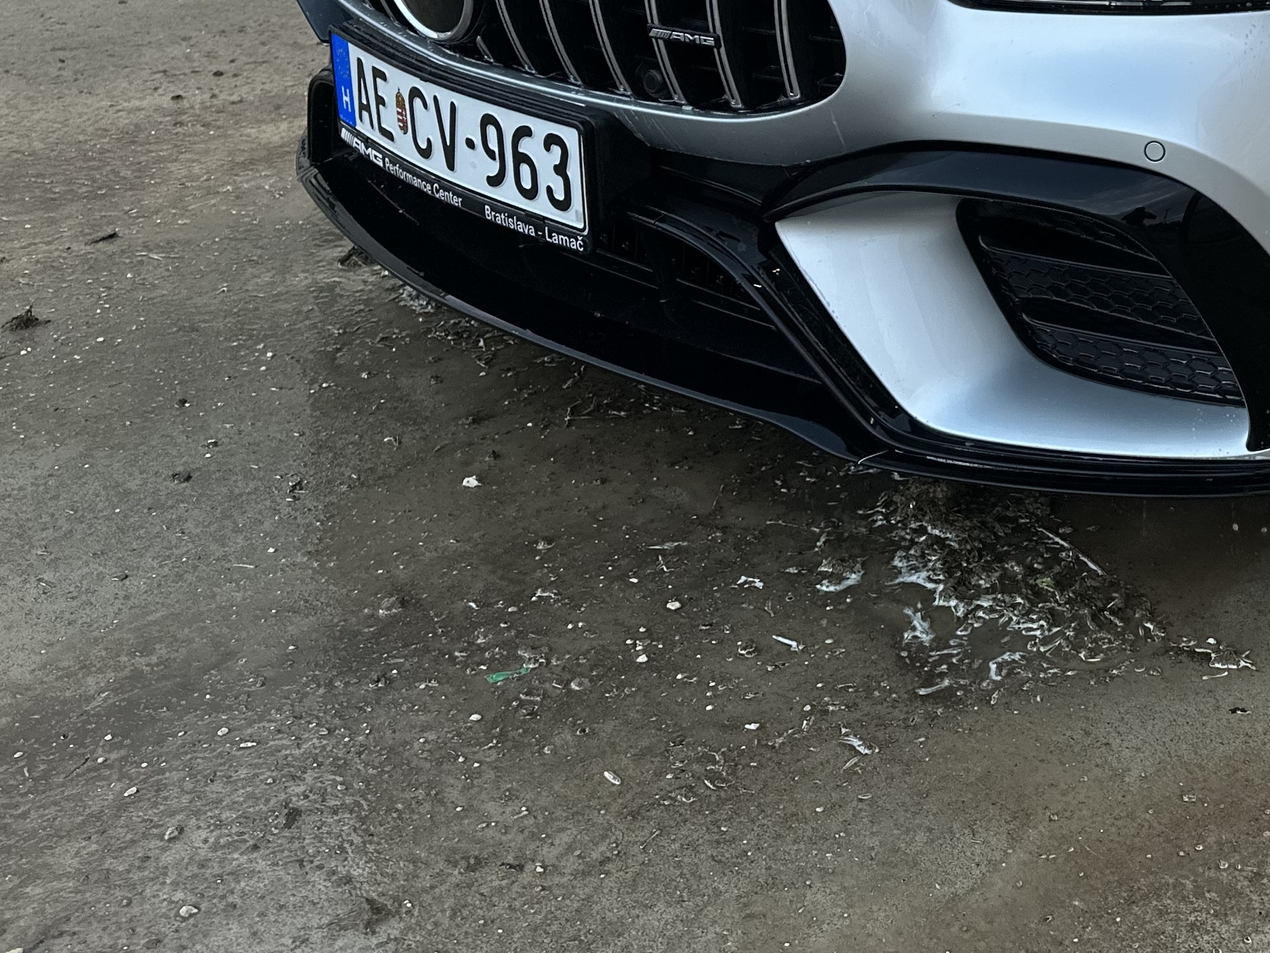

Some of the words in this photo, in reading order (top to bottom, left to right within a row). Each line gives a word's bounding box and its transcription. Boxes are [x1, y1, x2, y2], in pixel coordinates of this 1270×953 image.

[670, 31, 715, 46] AMG
[342, 85, 352, 113] H
[357, 57, 395, 142] AE
[408, 86, 572, 212] CV-963
[351, 137, 384, 167] AMG
[384, 158, 432, 195] Performance
[432, 183, 463, 208] Center
[484, 204, 536, 237] Bratislava
[545, 226, 585, 252] Lamač
